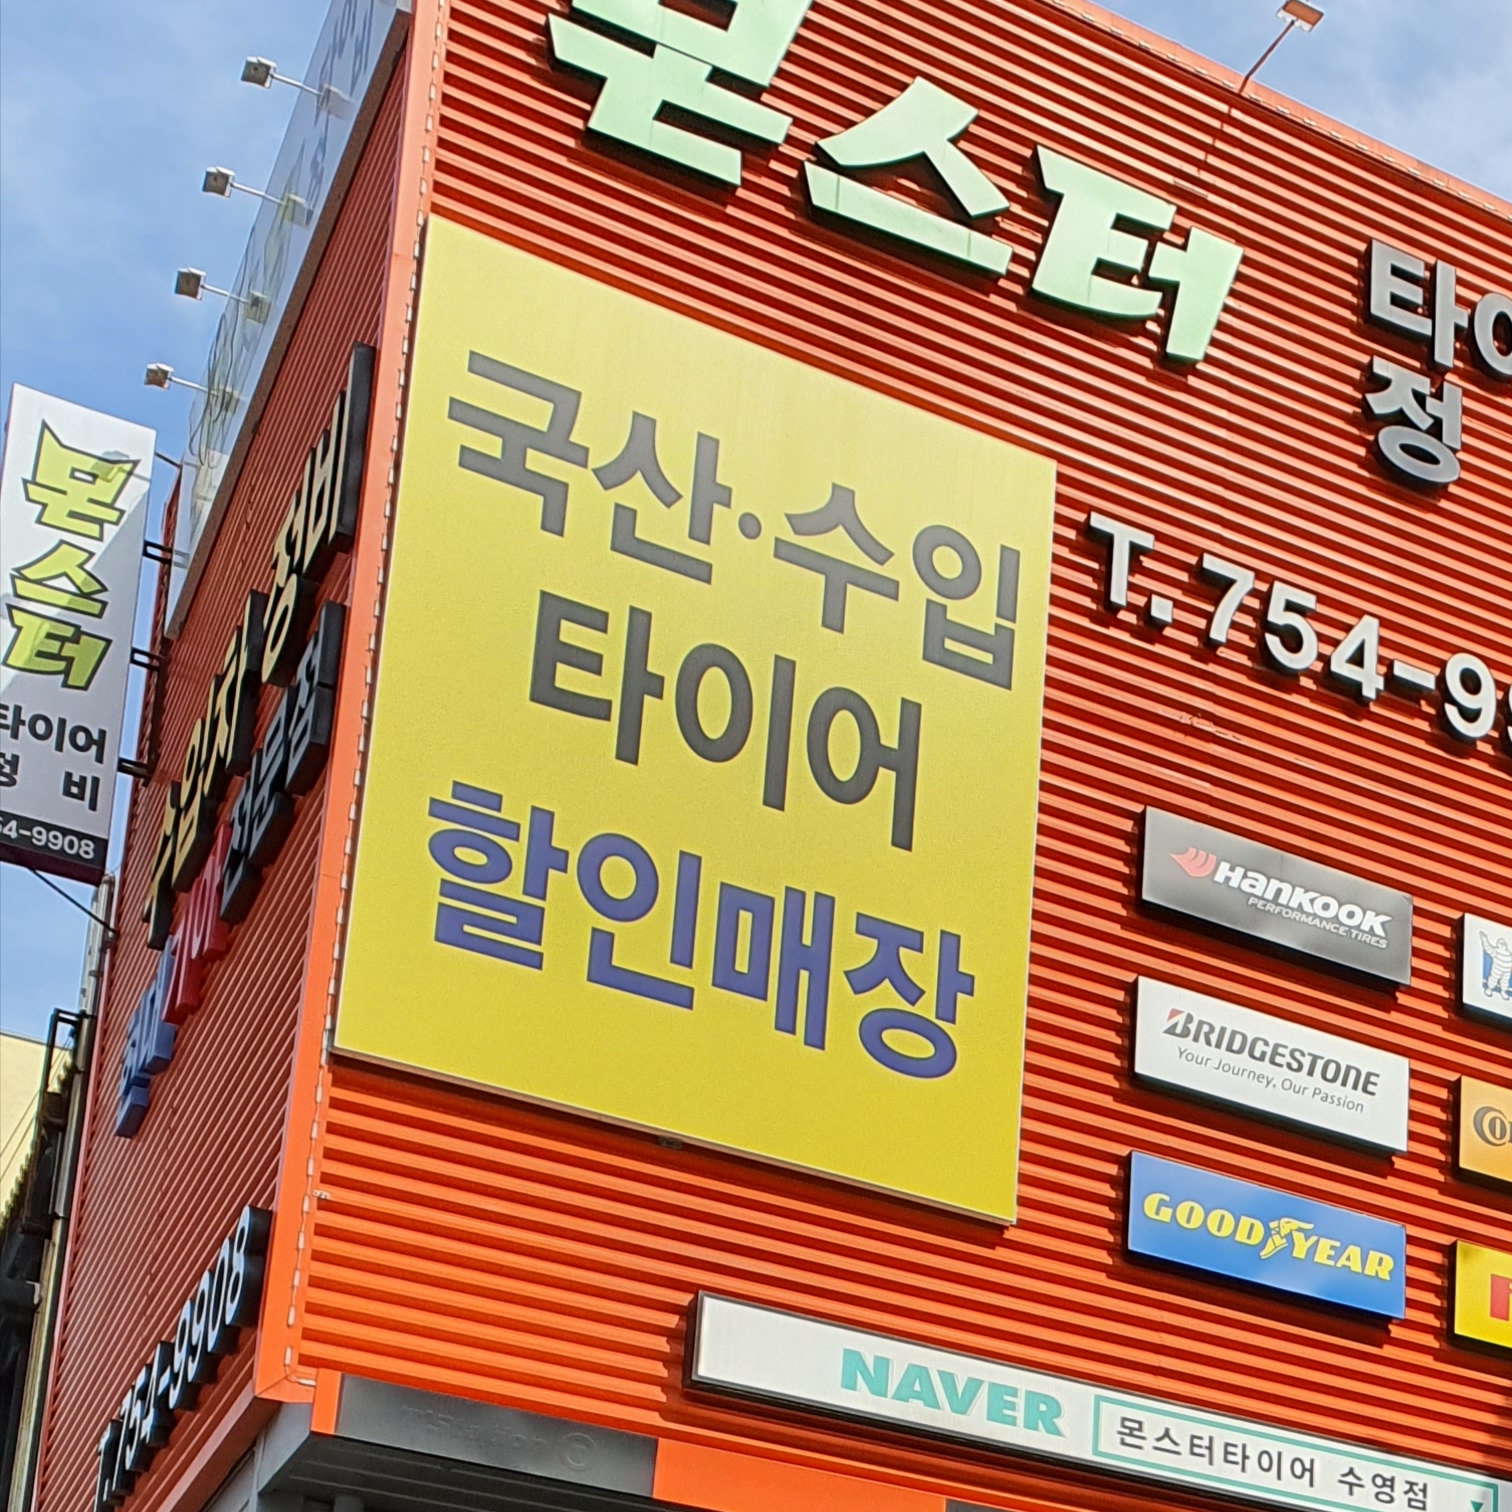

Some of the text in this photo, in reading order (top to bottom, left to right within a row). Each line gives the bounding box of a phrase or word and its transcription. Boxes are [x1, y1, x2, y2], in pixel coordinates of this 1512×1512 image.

[545, 0, 1243, 362] 몬스터
[2, 418, 141, 691] 몬스터
[529, 590, 922, 852] 타이어
[0, 815, 95, 859] 4-9908
[427, 779, 976, 1080] 할인매장
[1247, 896, 1388, 949] PERFORMANCE TIRES
[1162, 1007, 1381, 1097] BRIDGESTONE
[1176, 1045, 1365, 1114] Your Journey, Our Passion
[840, 1347, 1065, 1437] NAVER
[1116, 1415, 1429, 1512] 몬스터타이어 수영점
